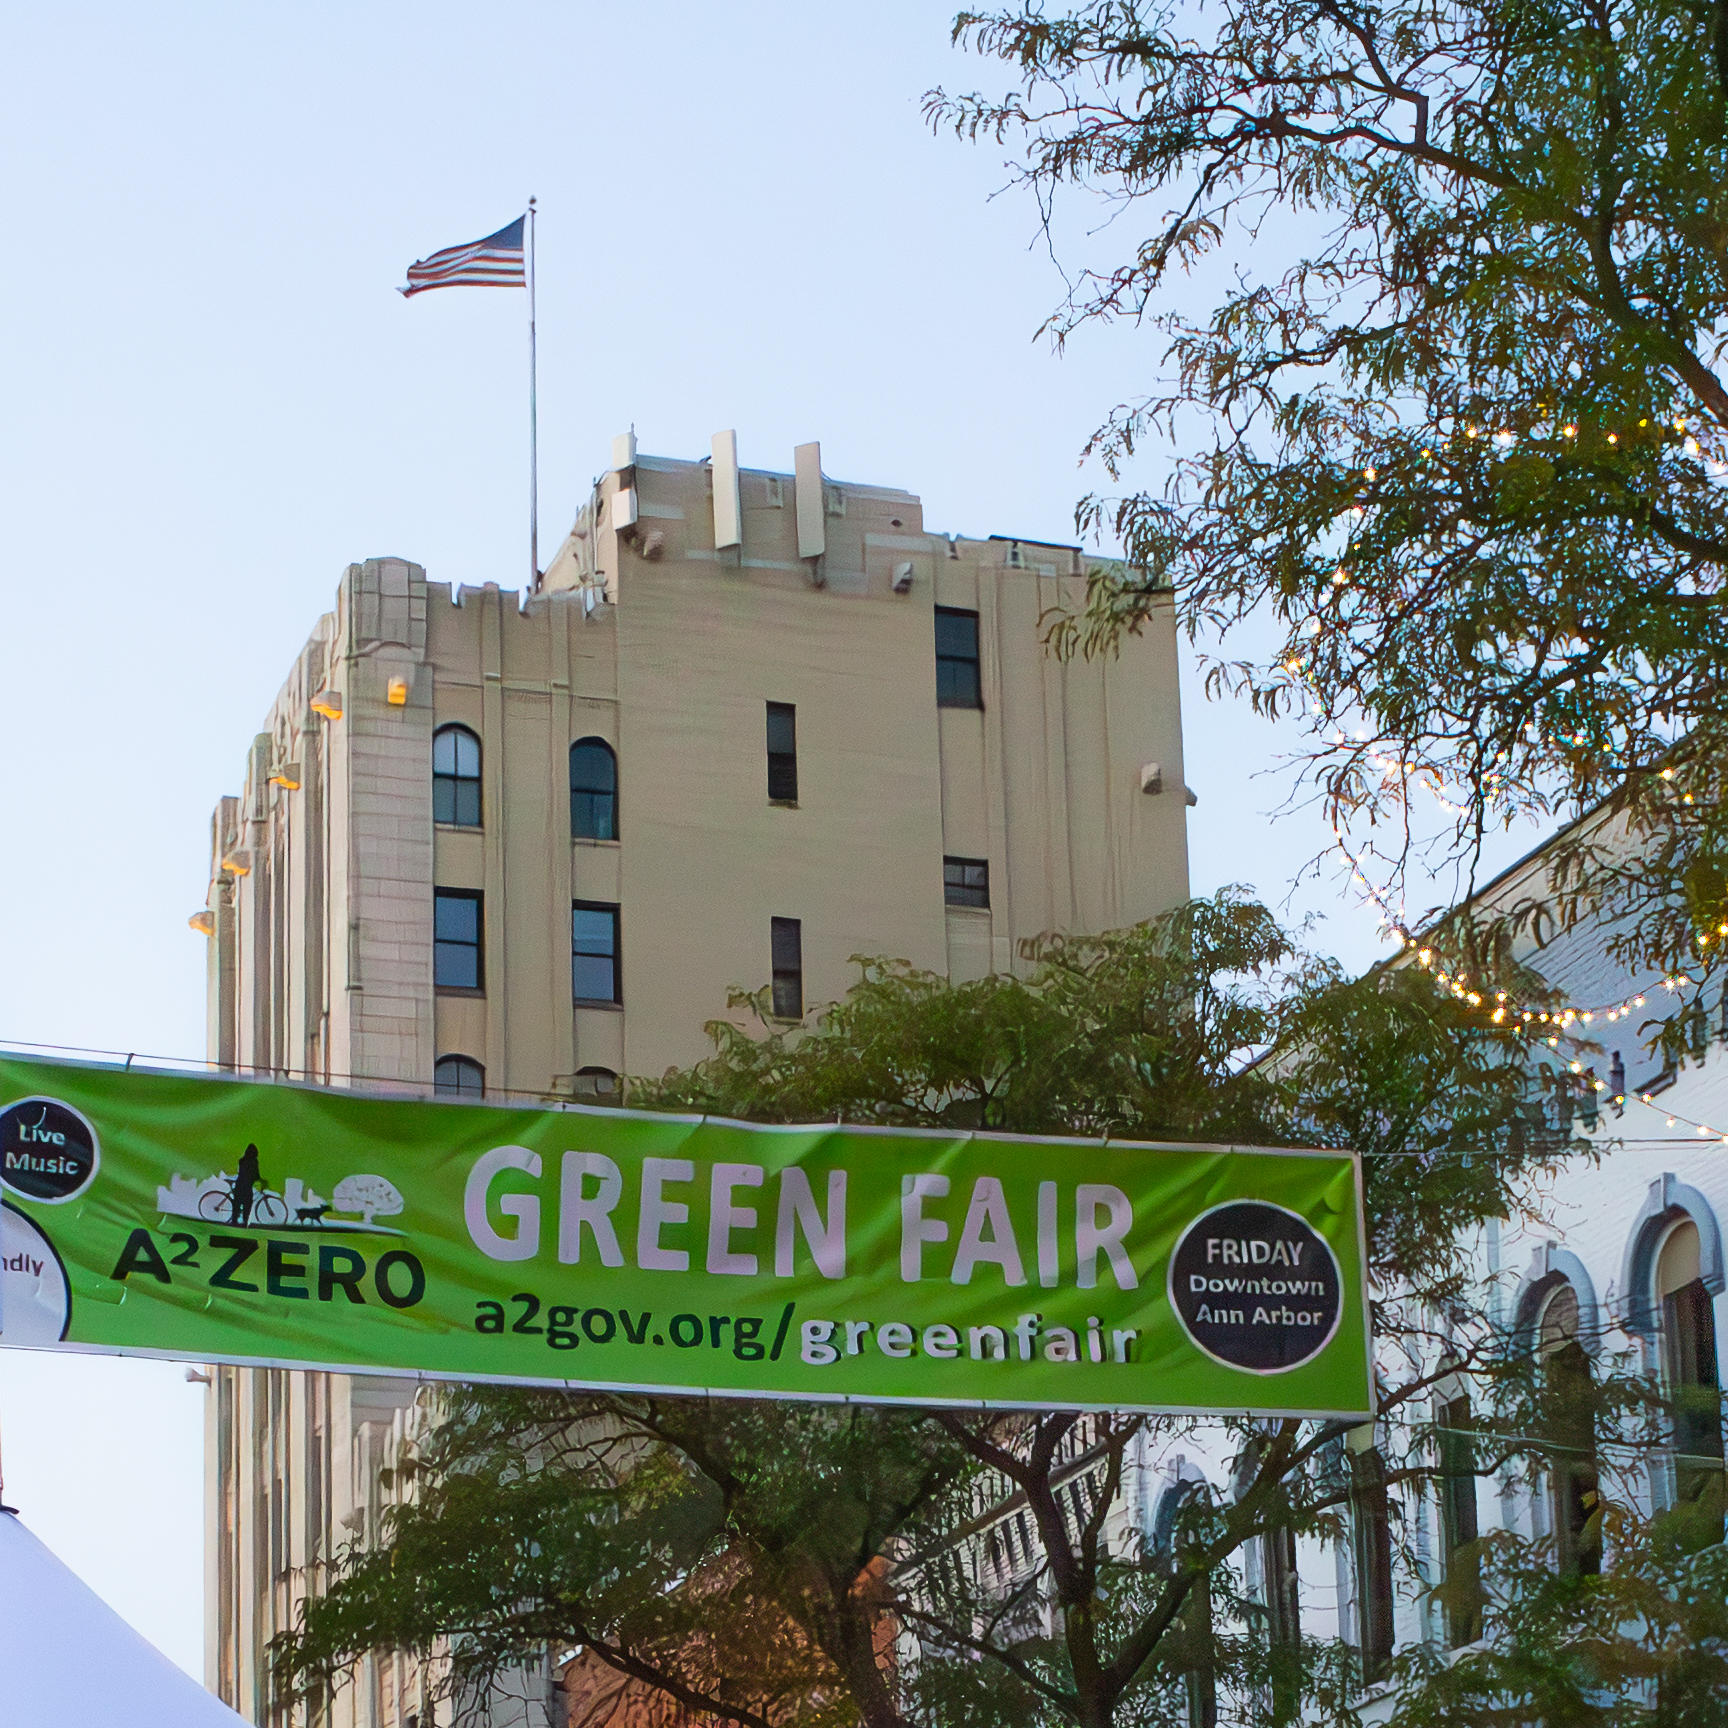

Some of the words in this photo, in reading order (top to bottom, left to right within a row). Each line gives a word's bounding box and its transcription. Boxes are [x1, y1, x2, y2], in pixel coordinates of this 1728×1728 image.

[18, 1123, 65, 1147] Live
[4, 1152, 79, 1176] Music
[465, 1144, 848, 1281] GREEN
[898, 1173, 1140, 1292] FAIR
[1205, 1238, 1304, 1267] FRIDAY
[110, 1227, 427, 1309] A2ZERO
[1189, 1274, 1325, 1296] Downtown
[1195, 1303, 1244, 1325] Ann
[1251, 1305, 1323, 1326] Arbor
[474, 1291, 1141, 1367] a2gov.org/greenfair
